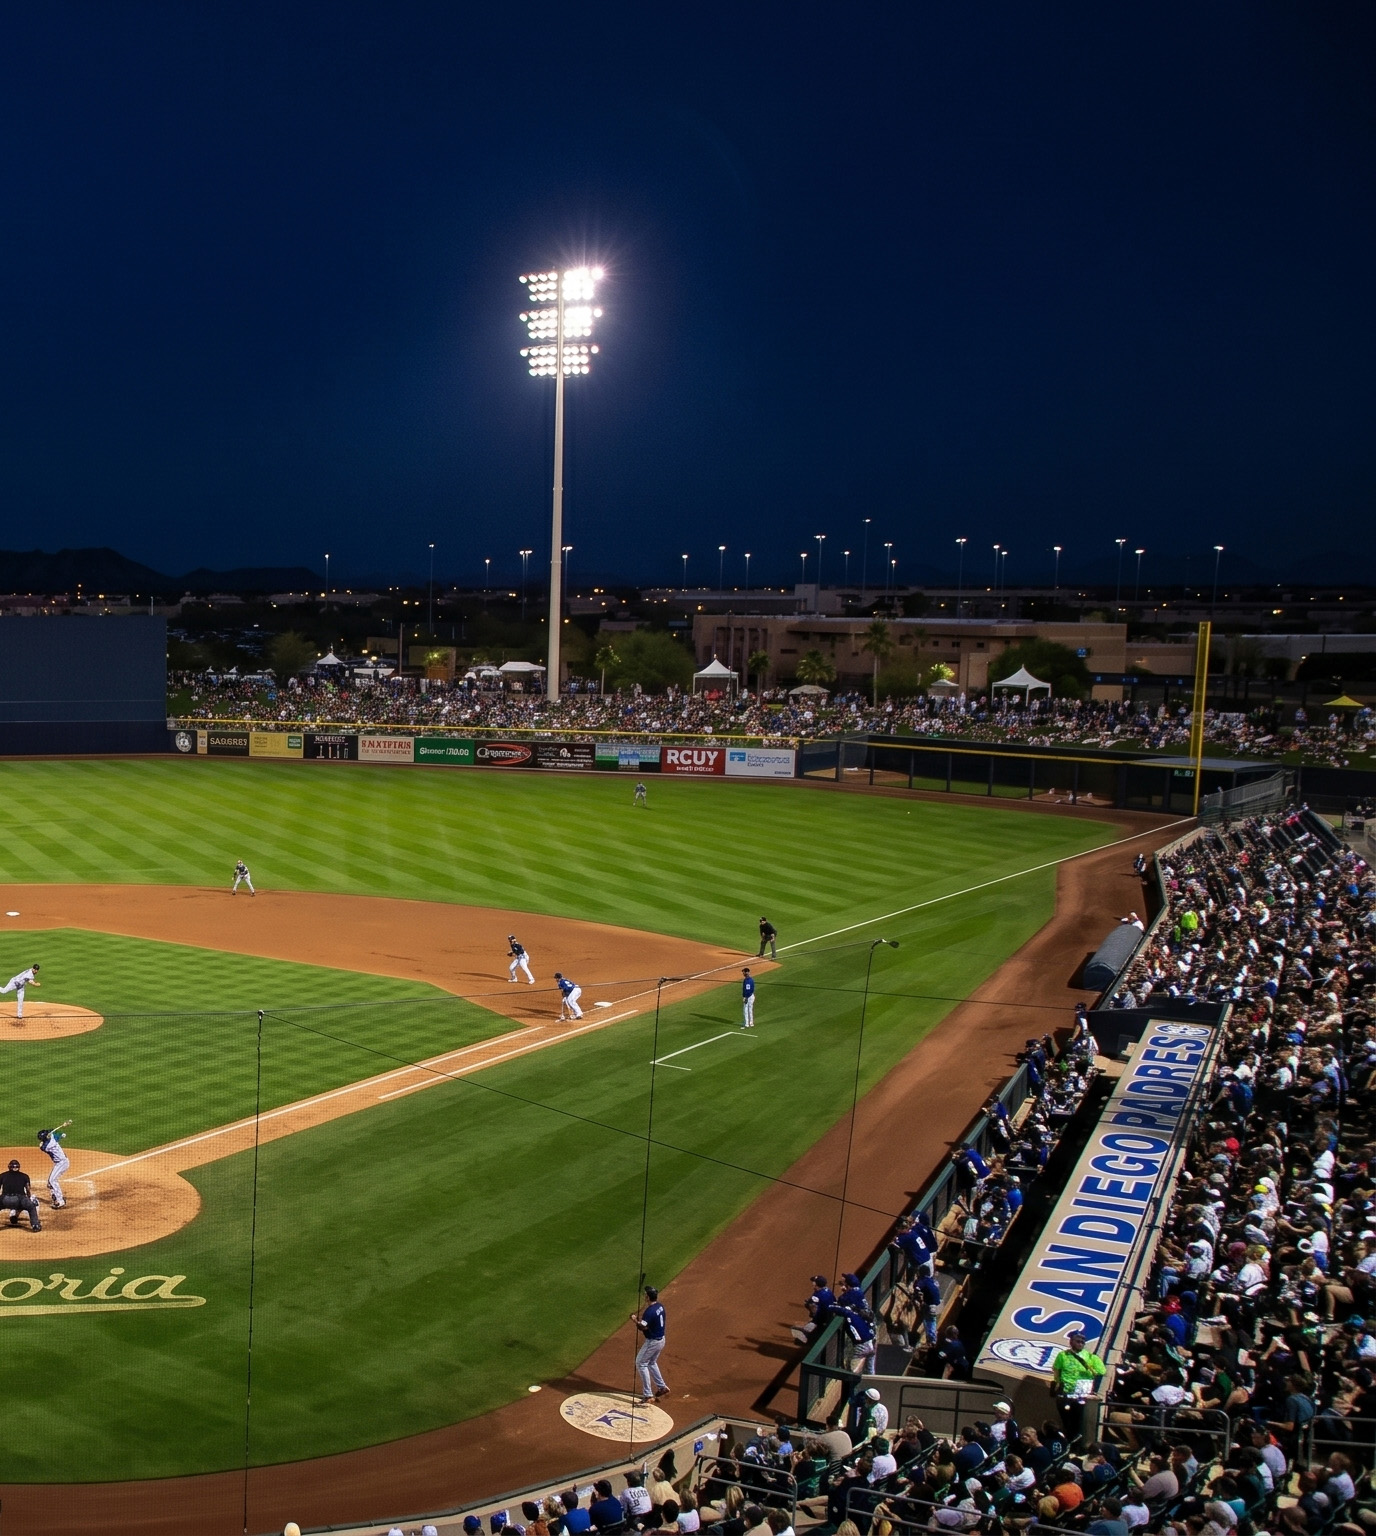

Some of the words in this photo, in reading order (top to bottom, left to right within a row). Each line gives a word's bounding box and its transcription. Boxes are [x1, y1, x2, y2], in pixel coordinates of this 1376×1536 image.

[666, 749, 719, 766] RCUY
[1110, 1035, 1208, 1131] PADRES
[1058, 1133, 1171, 1244] DIEGO
[1011, 1243, 1128, 1343] SAN
